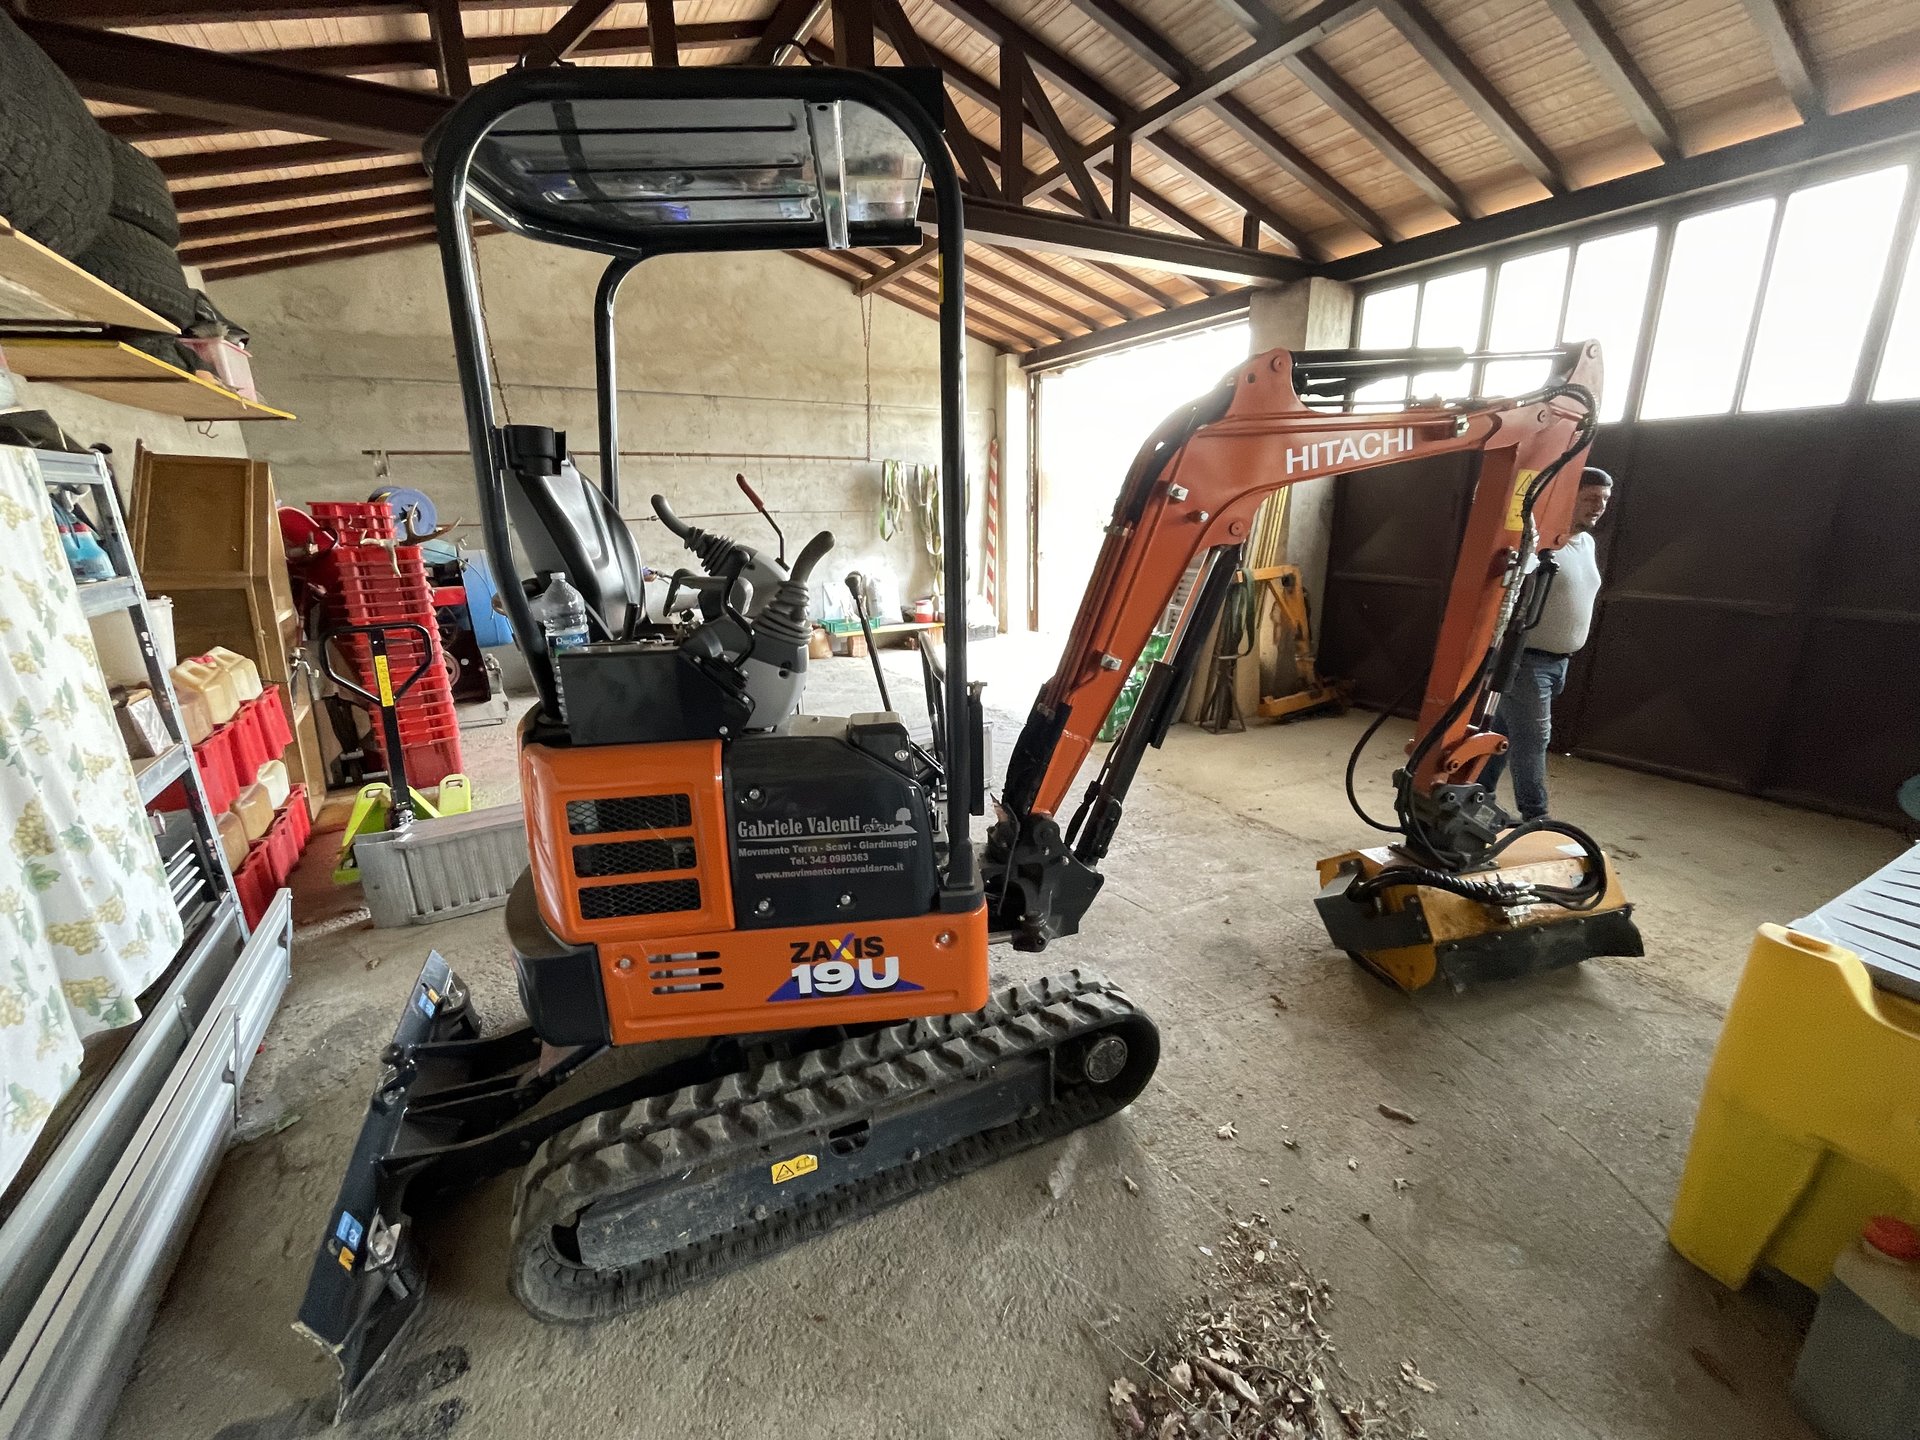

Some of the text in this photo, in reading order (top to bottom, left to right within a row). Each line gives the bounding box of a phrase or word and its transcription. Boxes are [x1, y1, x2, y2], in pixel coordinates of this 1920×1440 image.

[1286, 427, 1413, 474] HITACHI
[737, 815, 860, 838] Gabriele Valenti
[738, 846, 790, 857] Movimento
[792, 844, 818, 854] Terra
[825, 842, 852, 852] Scavi
[859, 839, 918, 850] Giardinaggio
[789, 853, 869, 866] Tel. 342 0980363
[755, 862, 905, 880] www.movimentoterravaldarno.it
[789, 932, 885, 964] ZAXIS
[791, 956, 900, 996] 19U
